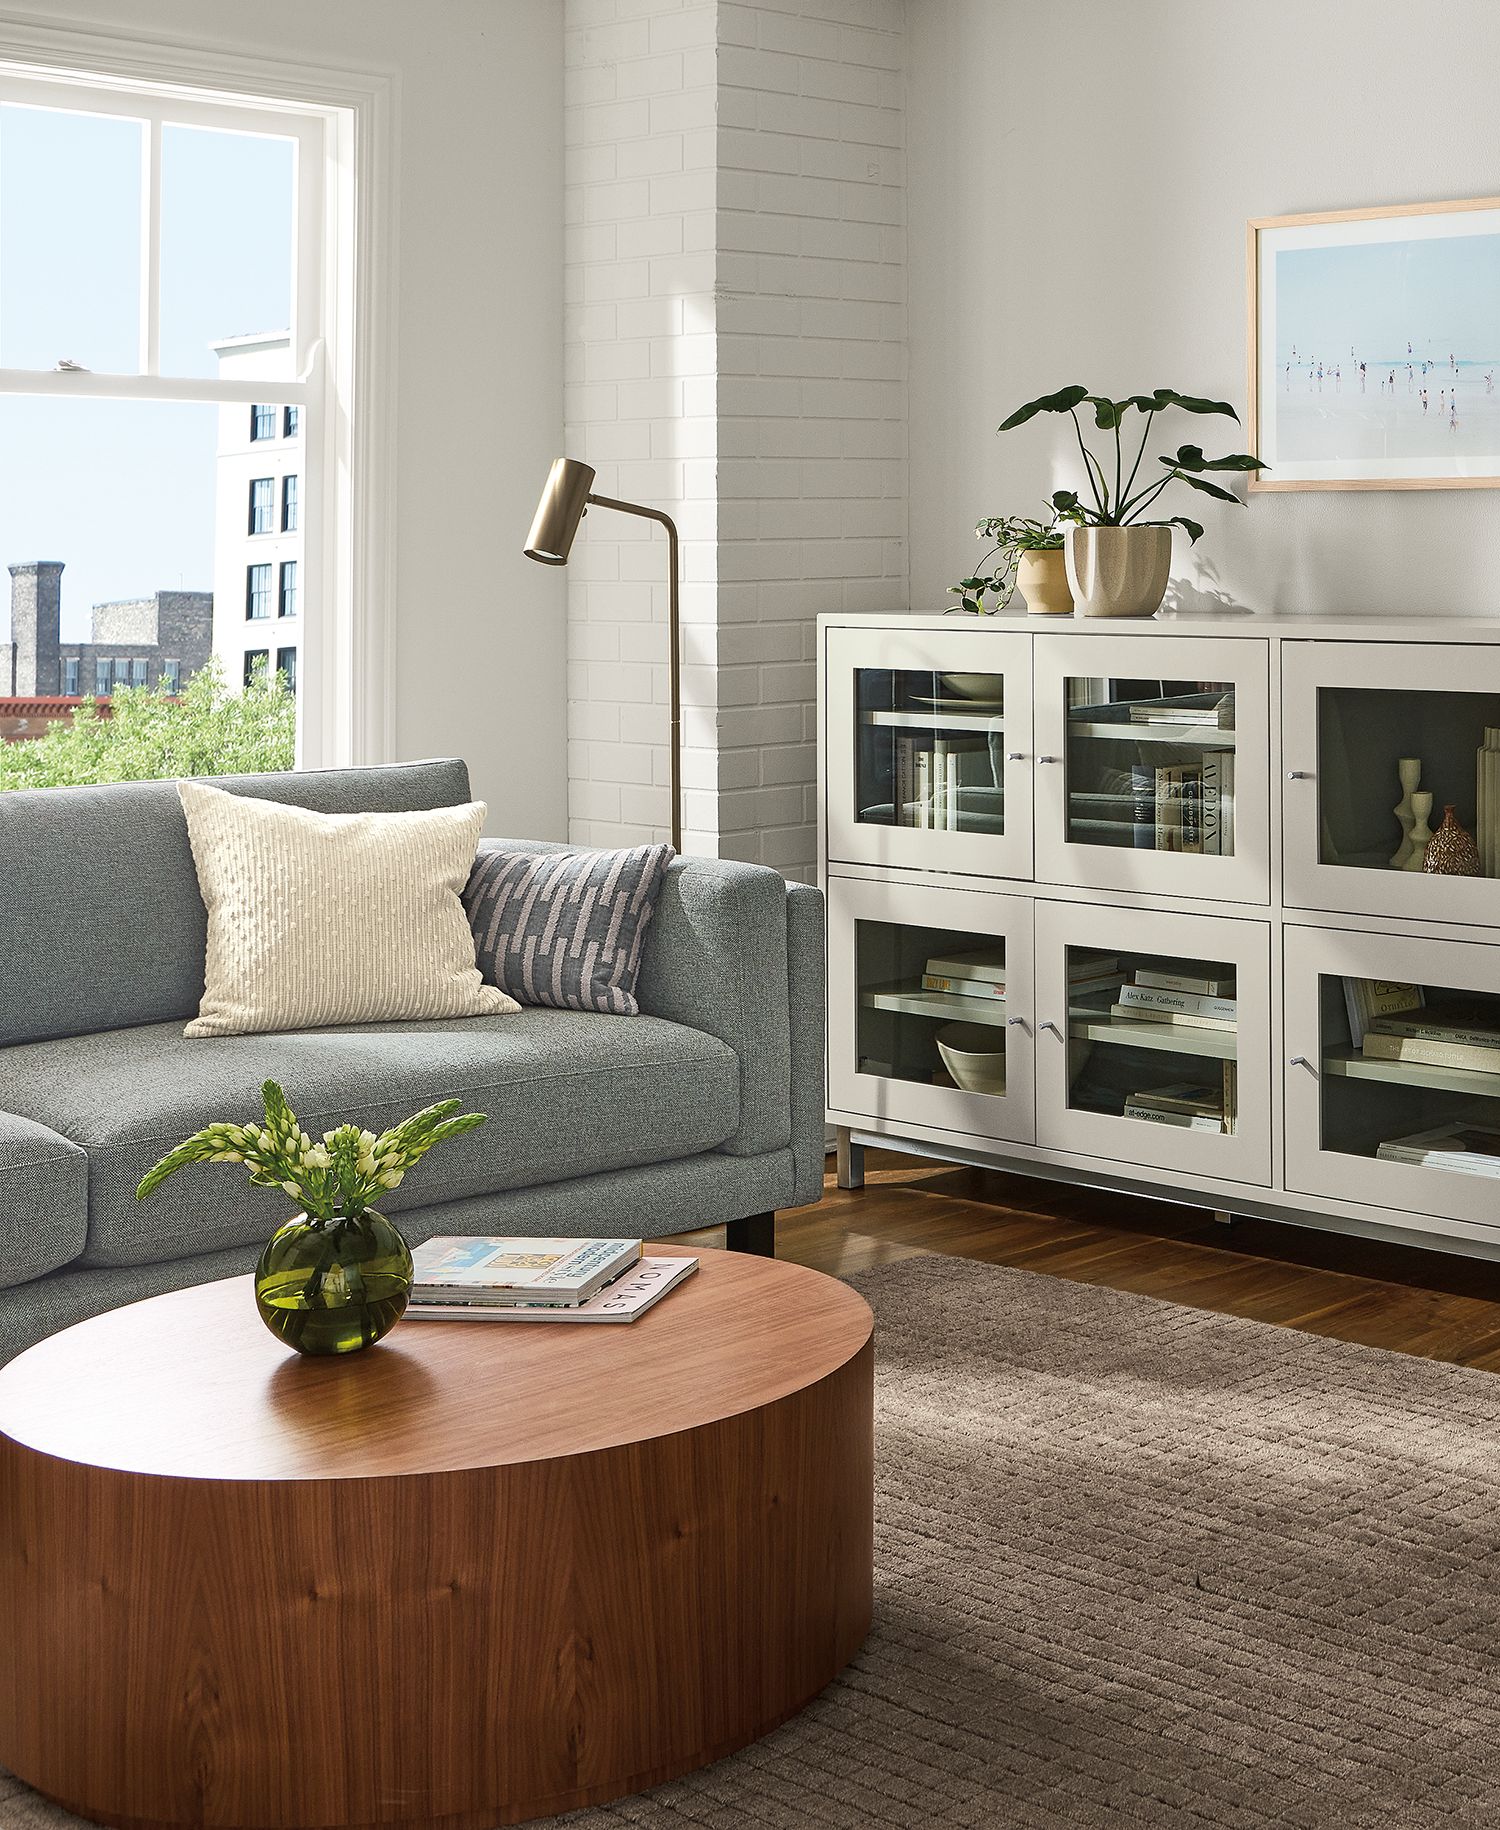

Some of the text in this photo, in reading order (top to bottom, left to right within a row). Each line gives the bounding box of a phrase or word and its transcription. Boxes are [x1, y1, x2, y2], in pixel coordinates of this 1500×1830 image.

[1203, 763, 1217, 840] AVEDON
[1126, 992, 1185, 1008] Alex Katz Gathering
[1128, 1109, 1166, 1121] at-edge.com
[603, 1262, 675, 1309] NOMAS
